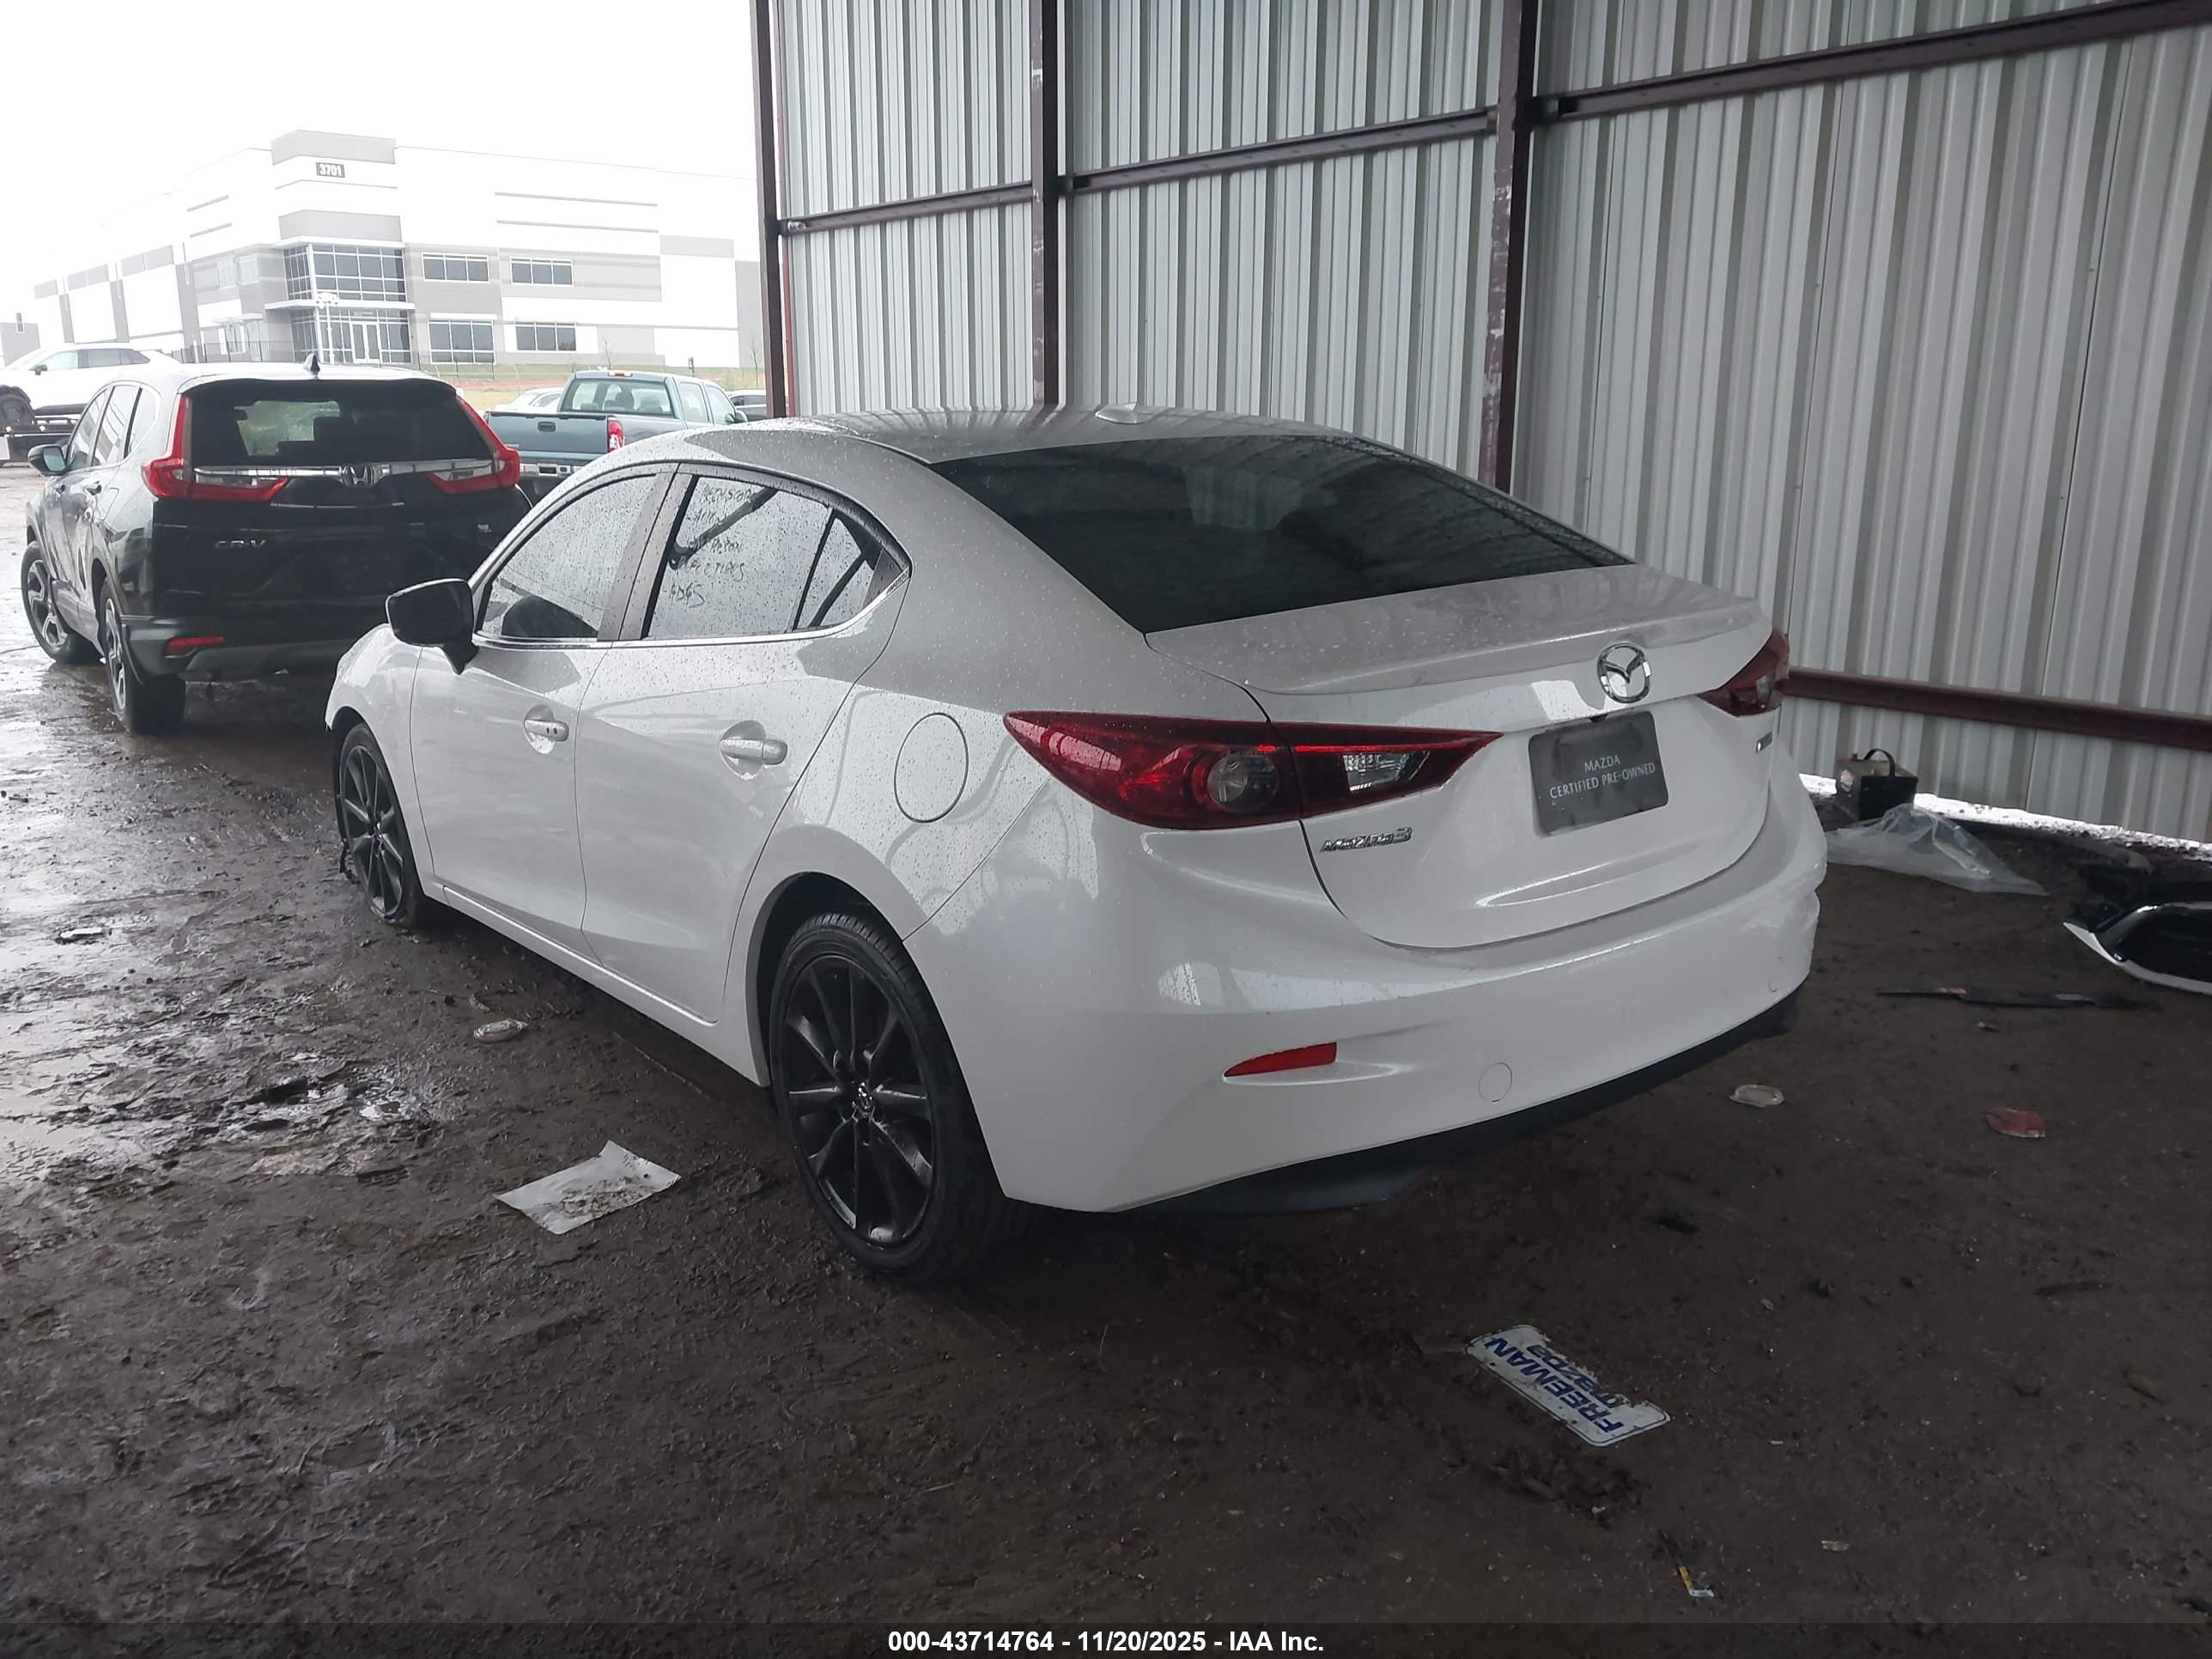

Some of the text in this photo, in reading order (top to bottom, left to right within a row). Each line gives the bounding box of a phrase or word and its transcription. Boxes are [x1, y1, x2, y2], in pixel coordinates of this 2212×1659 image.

[319, 163, 343, 177] 3701
[1584, 755, 1621, 773] MAZDA
[1550, 763, 1656, 799] CERTIFIED PRE-OWNED
[1484, 1337, 1624, 1432] FREEMAN
